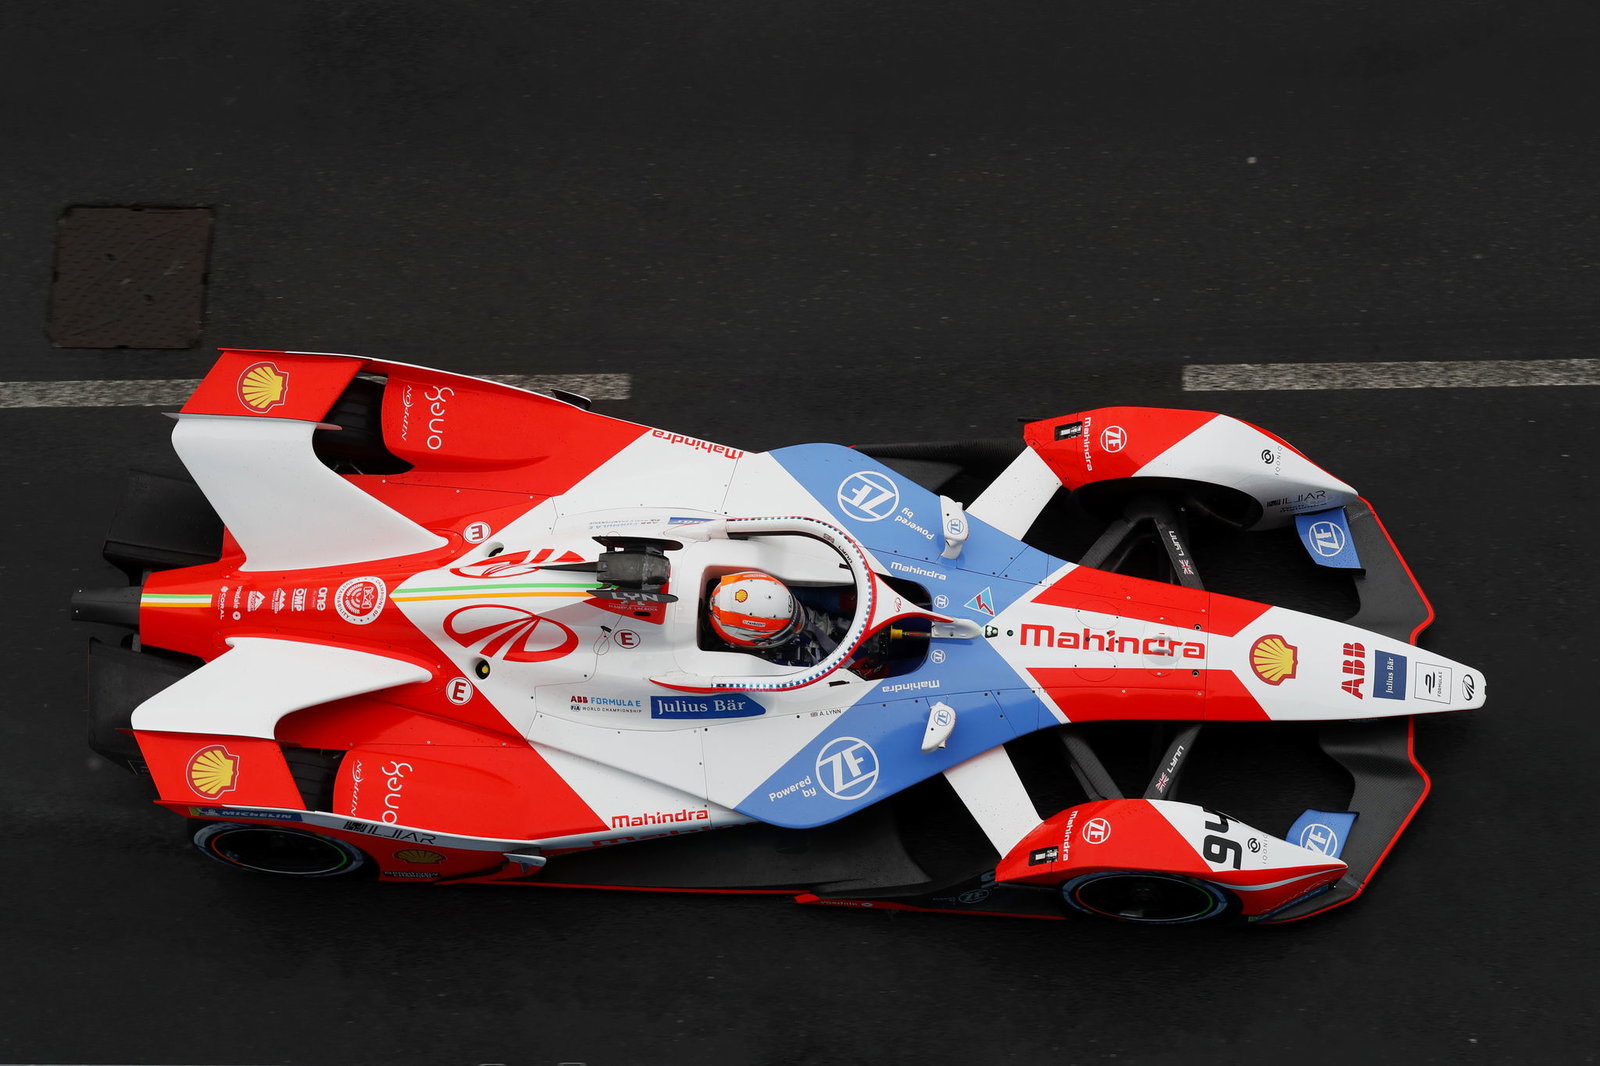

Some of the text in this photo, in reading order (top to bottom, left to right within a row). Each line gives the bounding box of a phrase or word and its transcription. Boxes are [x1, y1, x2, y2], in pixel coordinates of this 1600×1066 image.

[401, 385, 414, 441] NIPPON
[651, 428, 744, 460] Mahindra
[1084, 417, 1093, 472] Mahindra
[1100, 425, 1127, 453] ZF
[838, 471, 899, 521] ZF
[901, 506, 914, 519] by
[893, 514, 935, 541] Powered
[946, 518, 964, 535] ZF
[1309, 520, 1345, 557] ZF
[890, 561, 947, 581] Mahindra
[293, 588, 306, 612] OMP
[316, 586, 328, 611] one
[934, 594, 949, 609] ZF
[1019, 623, 1206, 660] Mahindra
[931, 649, 945, 664] ZF
[1340, 641, 1366, 700] ABB
[881, 680, 940, 693] Mahindra
[1385, 672, 1394, 694] Julius
[570, 695, 588, 704] ABB
[591, 697, 634, 706] FORMULA
[657, 698, 747, 716] Julius Bär
[826, 708, 842, 716] LYNN
[933, 709, 952, 727] ZF
[816, 738, 880, 798] ZF
[350, 760, 364, 816] NIPPON
[768, 775, 812, 802] Powered
[801, 785, 817, 798] by
[222, 809, 292, 820] MICHELIN
[611, 808, 709, 829] Mahindra
[1062, 810, 1078, 862] Mahindra
[1082, 817, 1111, 844] ZF
